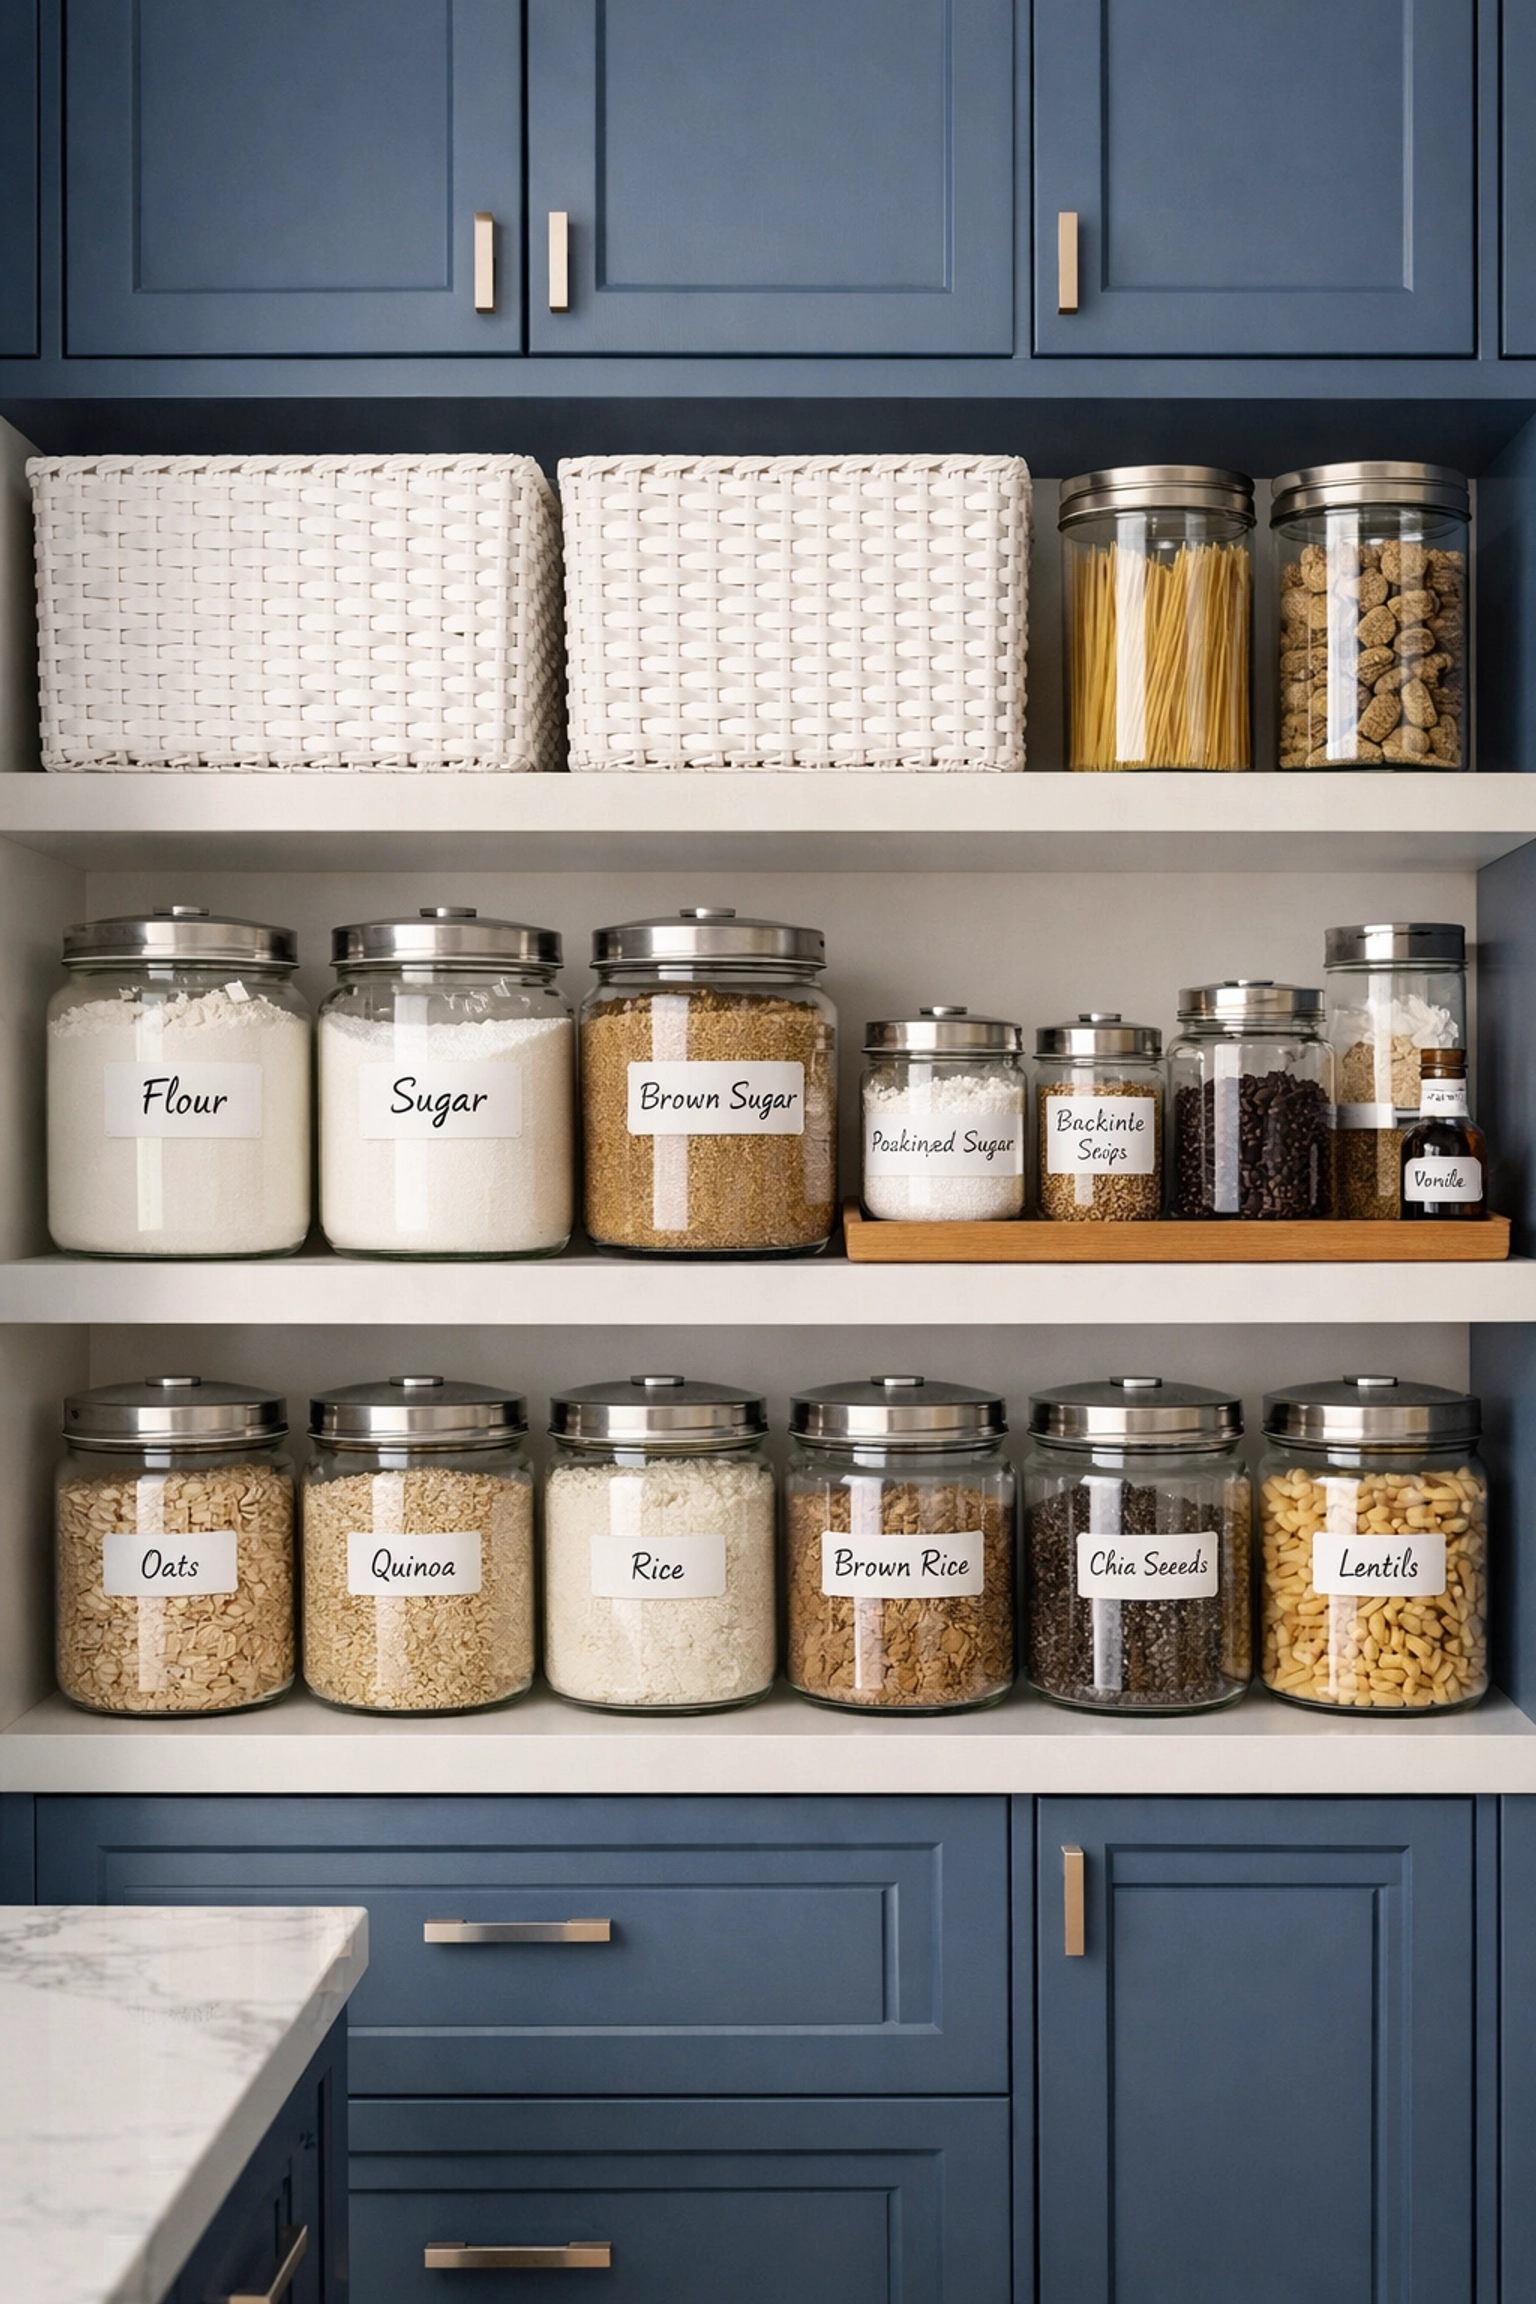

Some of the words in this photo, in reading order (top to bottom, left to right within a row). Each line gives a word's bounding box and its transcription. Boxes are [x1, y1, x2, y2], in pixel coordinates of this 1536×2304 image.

[142, 1076, 228, 1115] Flour
[390, 1076, 489, 1129] Sugar
[640, 1082, 720, 1111] Brown
[729, 1080, 798, 1121] Sugar
[963, 1129, 1015, 1161] Sugar
[141, 1548, 200, 1580] Oats
[371, 1547, 456, 1583] Quinoa
[631, 1551, 685, 1581] Rice
[834, 1548, 911, 1578] Brown
[920, 1548, 971, 1577] Rice
[1090, 1548, 1137, 1577] Chia
[1144, 1548, 1209, 1577] Seeeds
[1339, 1547, 1419, 1578] Lentils
